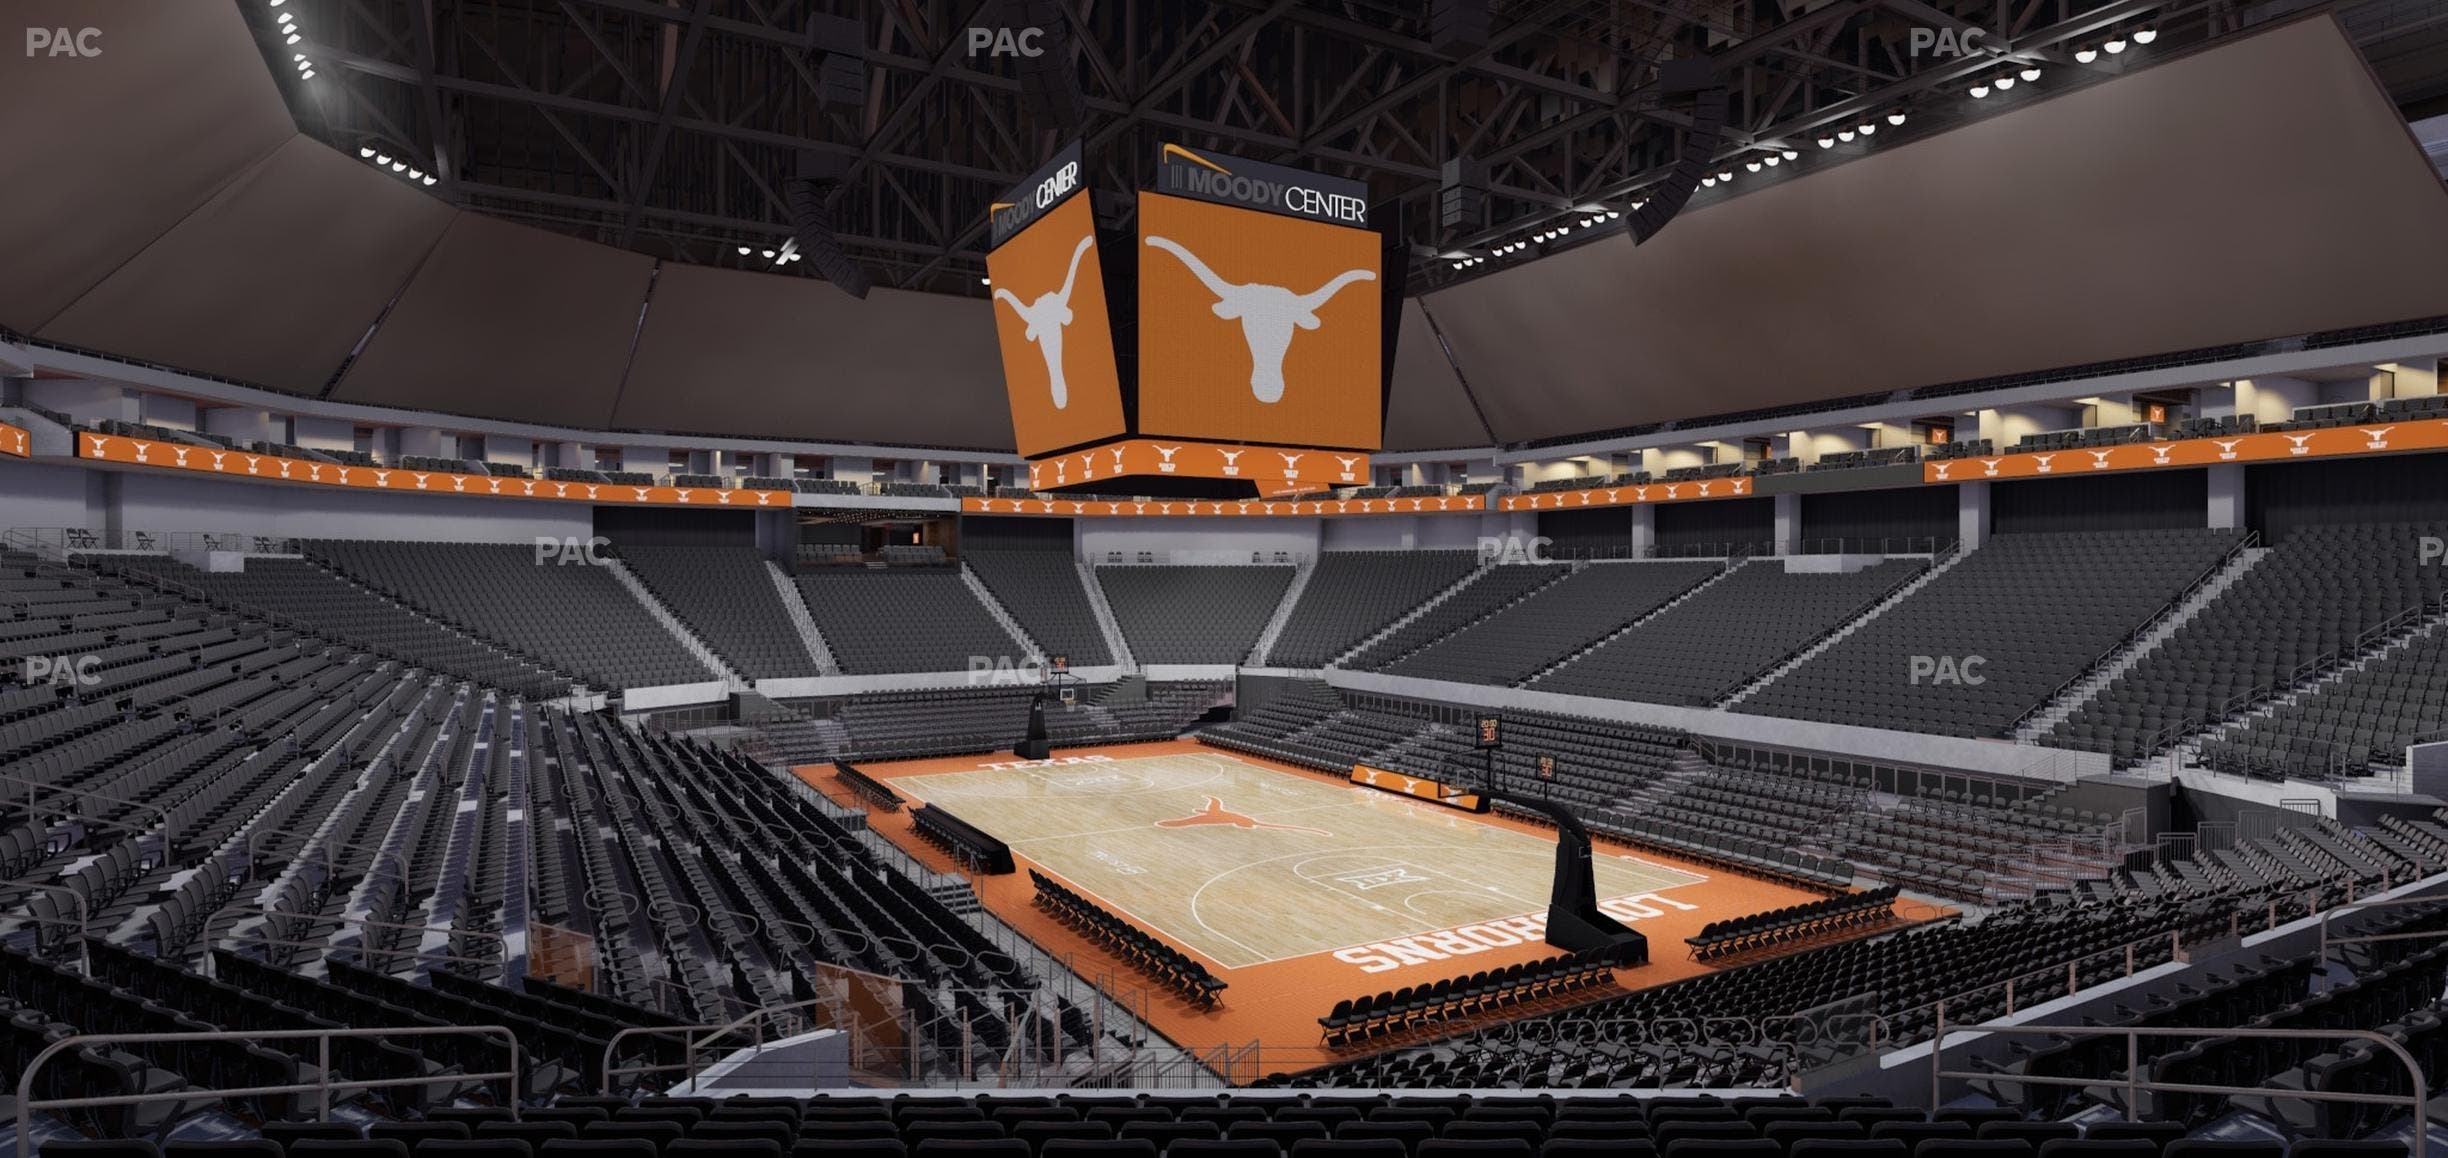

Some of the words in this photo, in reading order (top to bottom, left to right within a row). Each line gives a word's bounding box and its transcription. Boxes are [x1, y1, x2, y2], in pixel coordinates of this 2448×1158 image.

[1036, 161, 1078, 209] CENTER
[1188, 166, 1284, 206] MOODY
[1285, 186, 1366, 223] CENTER
[1483, 728, 1495, 741] 30
[977, 754, 1114, 772] TEXAS
[1333, 893, 1698, 974] LOHORNS
